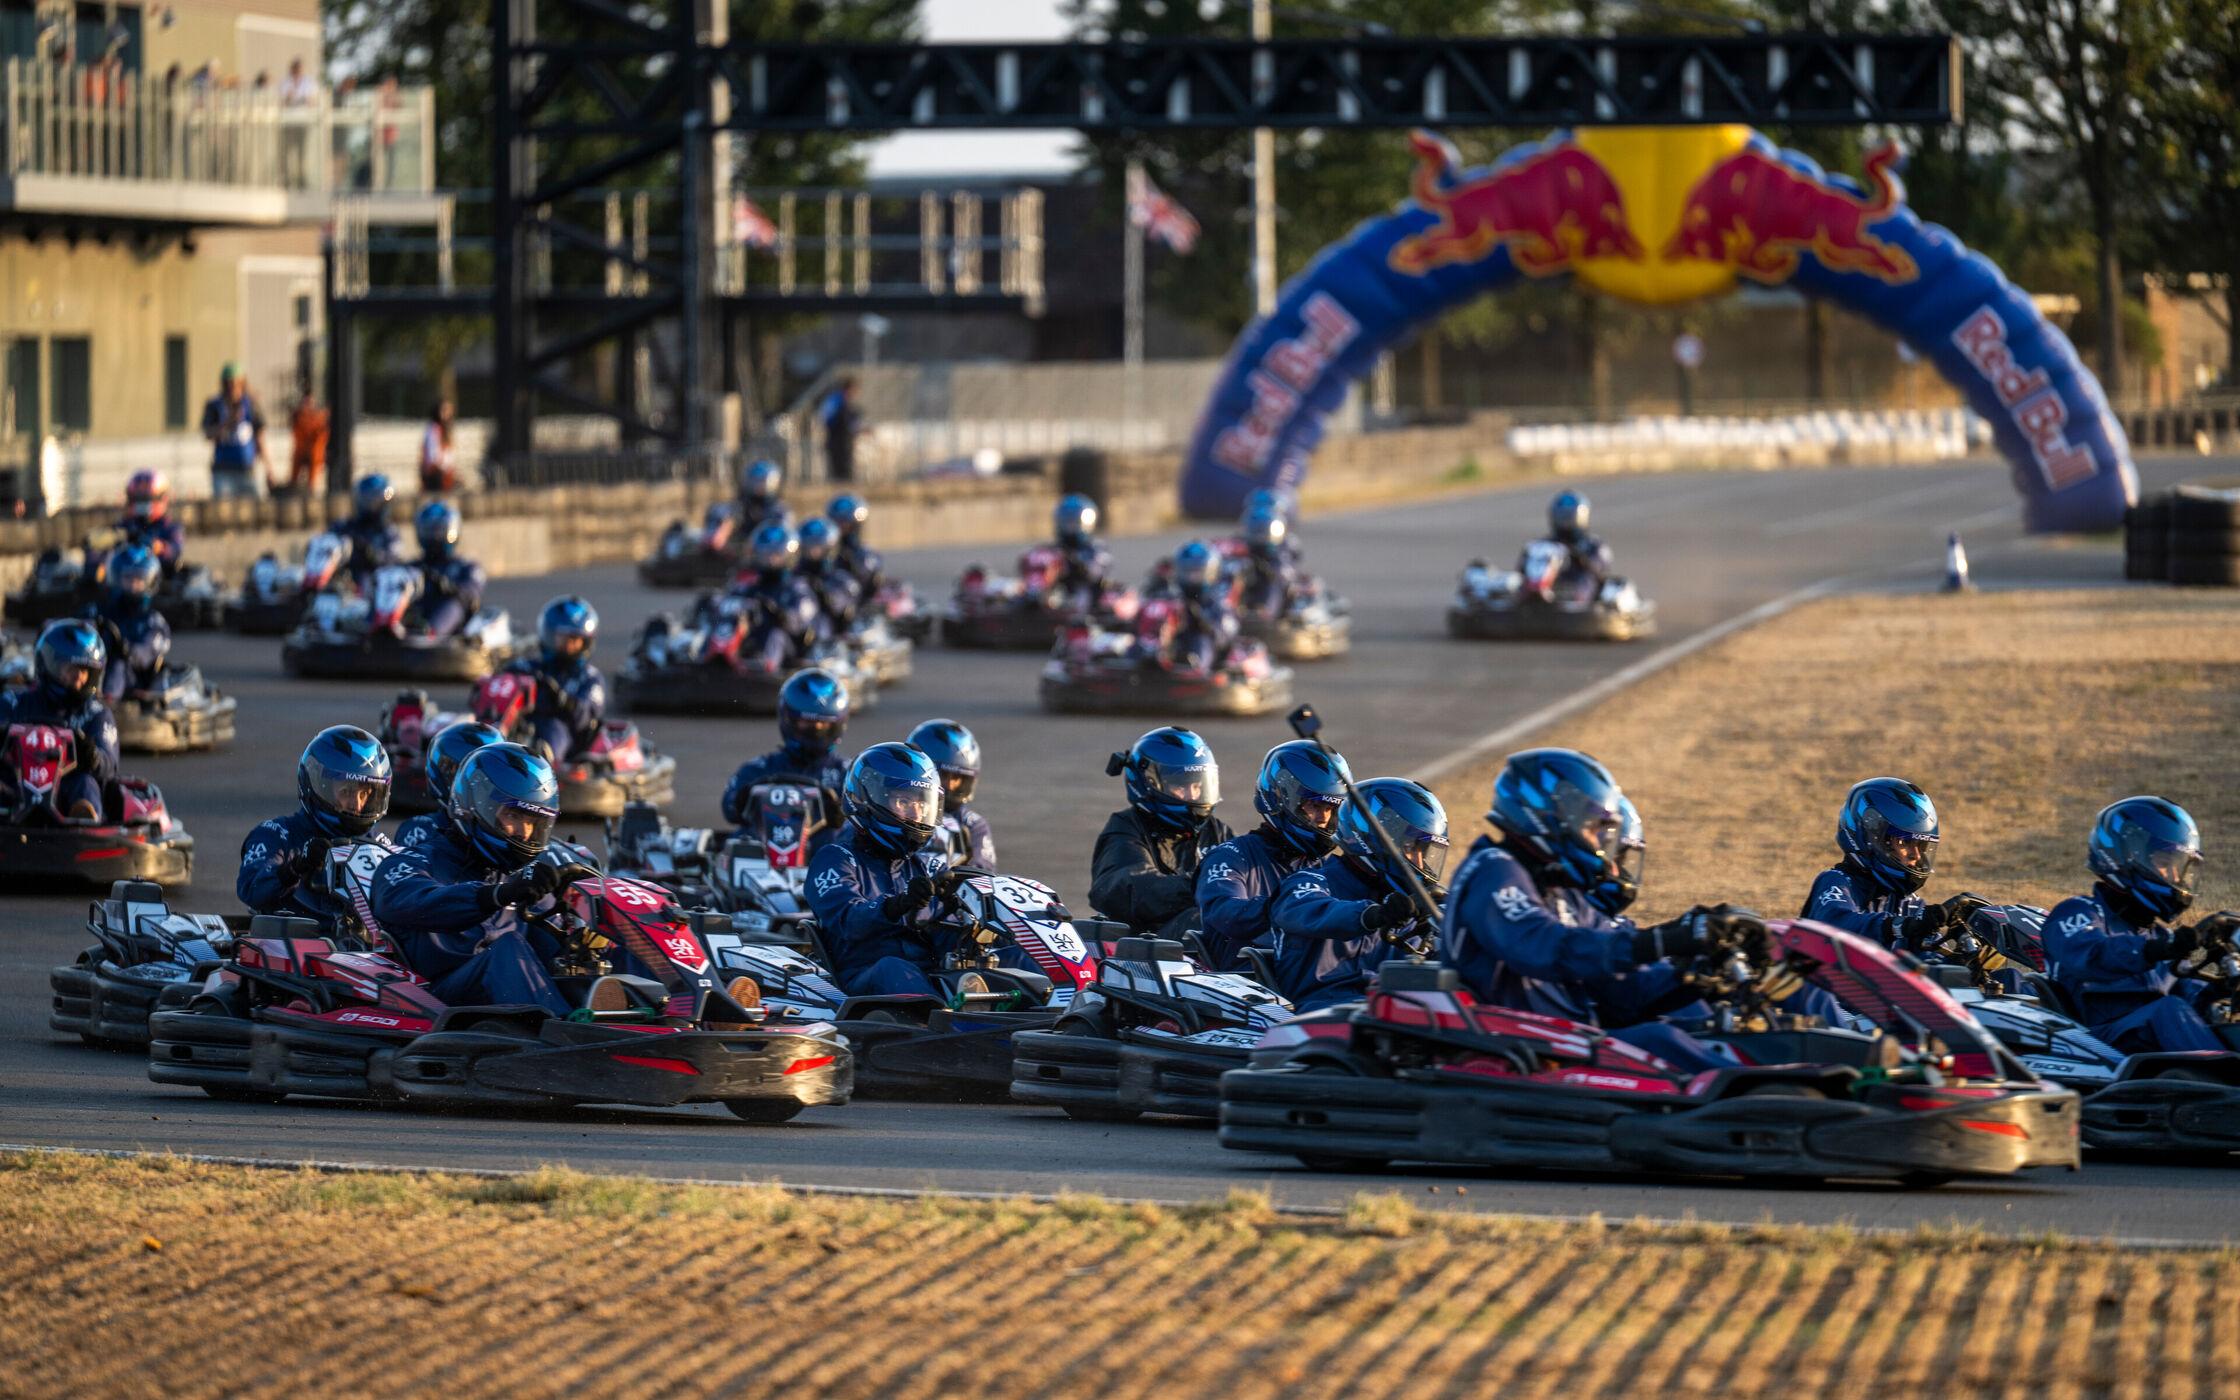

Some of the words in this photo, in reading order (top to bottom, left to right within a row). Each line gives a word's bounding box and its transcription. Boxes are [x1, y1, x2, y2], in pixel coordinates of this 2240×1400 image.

[1211, 368, 1303, 474] Red
[1261, 289, 1363, 394] Bull
[1951, 304, 2052, 410] Red
[2011, 387, 2099, 493] Bull
[26, 729, 57, 748] 46
[346, 772, 367, 782] KART
[911, 780, 931, 789] KART
[769, 789, 800, 806] 03
[1322, 795, 1342, 804] KART
[517, 801, 540, 812] KART
[611, 886, 658, 905] 55
[1002, 886, 1043, 904] 32
[356, 1015, 400, 1026] SODI
